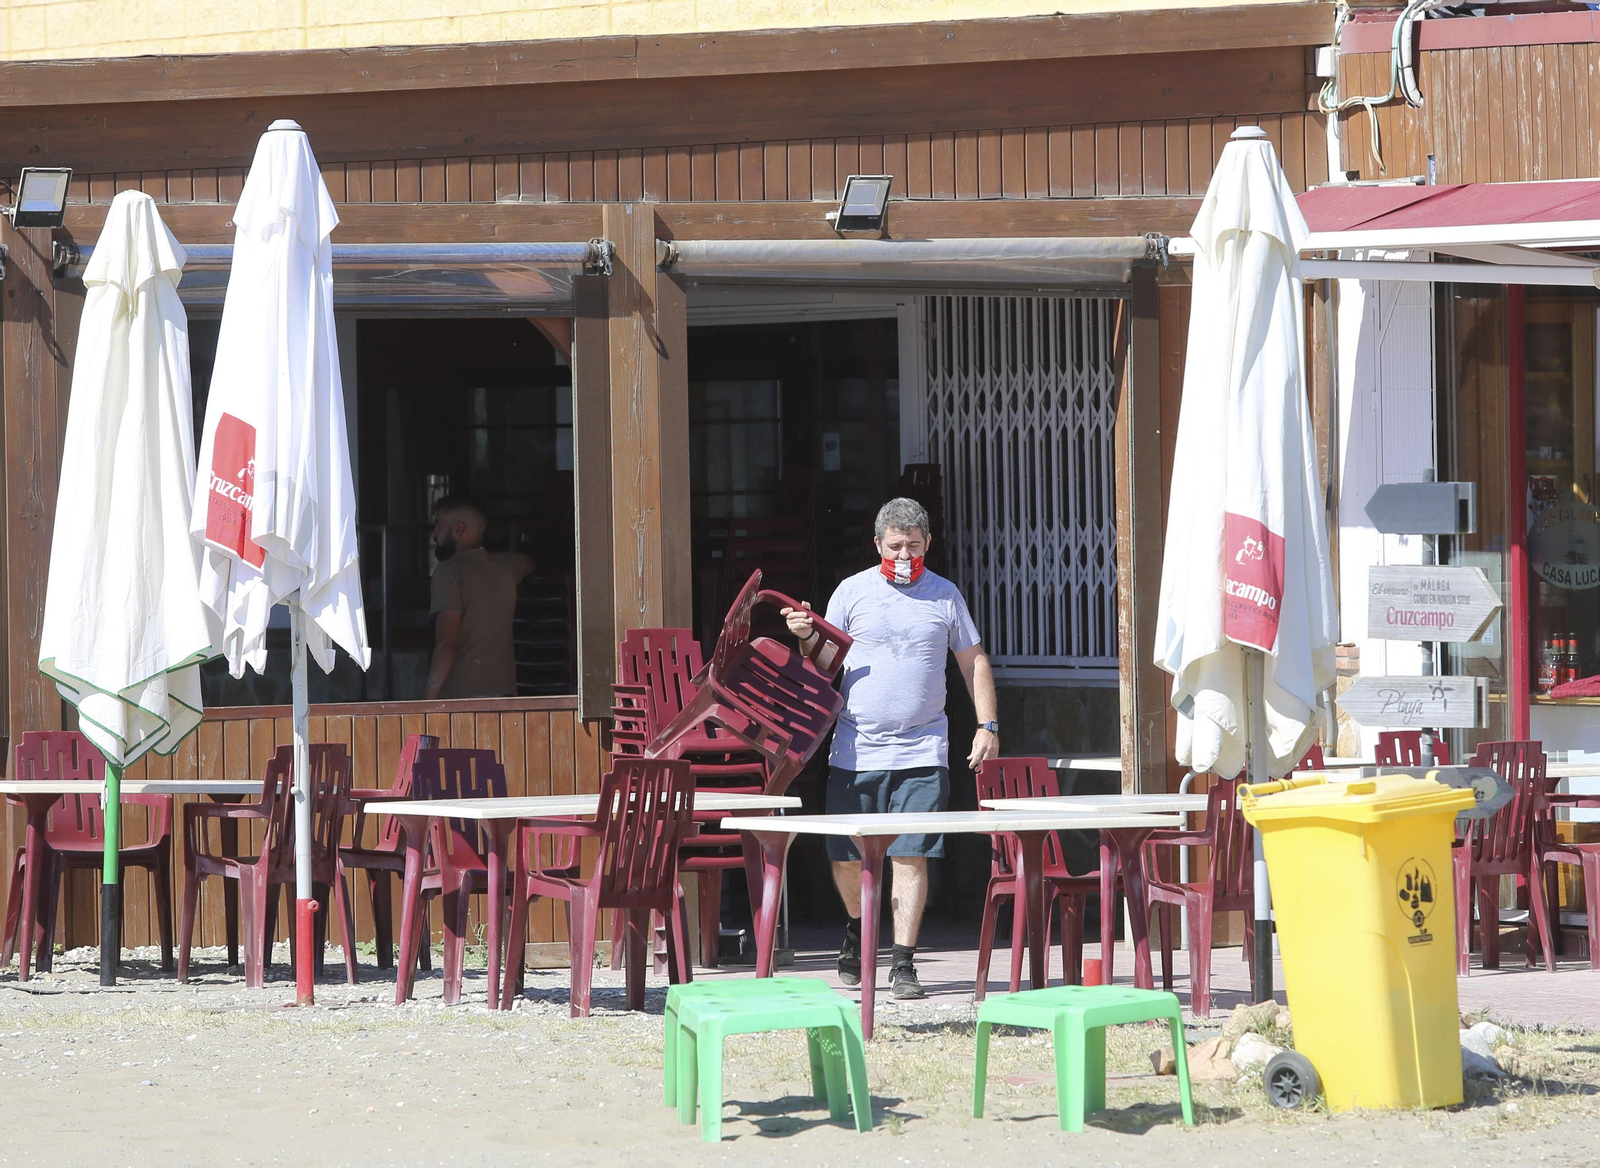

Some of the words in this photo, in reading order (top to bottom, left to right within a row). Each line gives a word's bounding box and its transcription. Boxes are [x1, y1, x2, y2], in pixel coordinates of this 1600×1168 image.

[1542, 561, 1572, 585] CASA
[1225, 577, 1276, 610] zcampo
[1371, 582, 1384, 595] El
[1384, 587, 1409, 596] verano
[1421, 577, 1451, 591] MÁLAGA
[1413, 594, 1428, 604] COMO
[1429, 594, 1436, 604] EN
[1437, 593, 1456, 605] NINGÚN
[1457, 595, 1471, 605] SITIO
[1386, 606, 1454, 631] Cruzcampo
[1377, 688, 1424, 725] Playa
